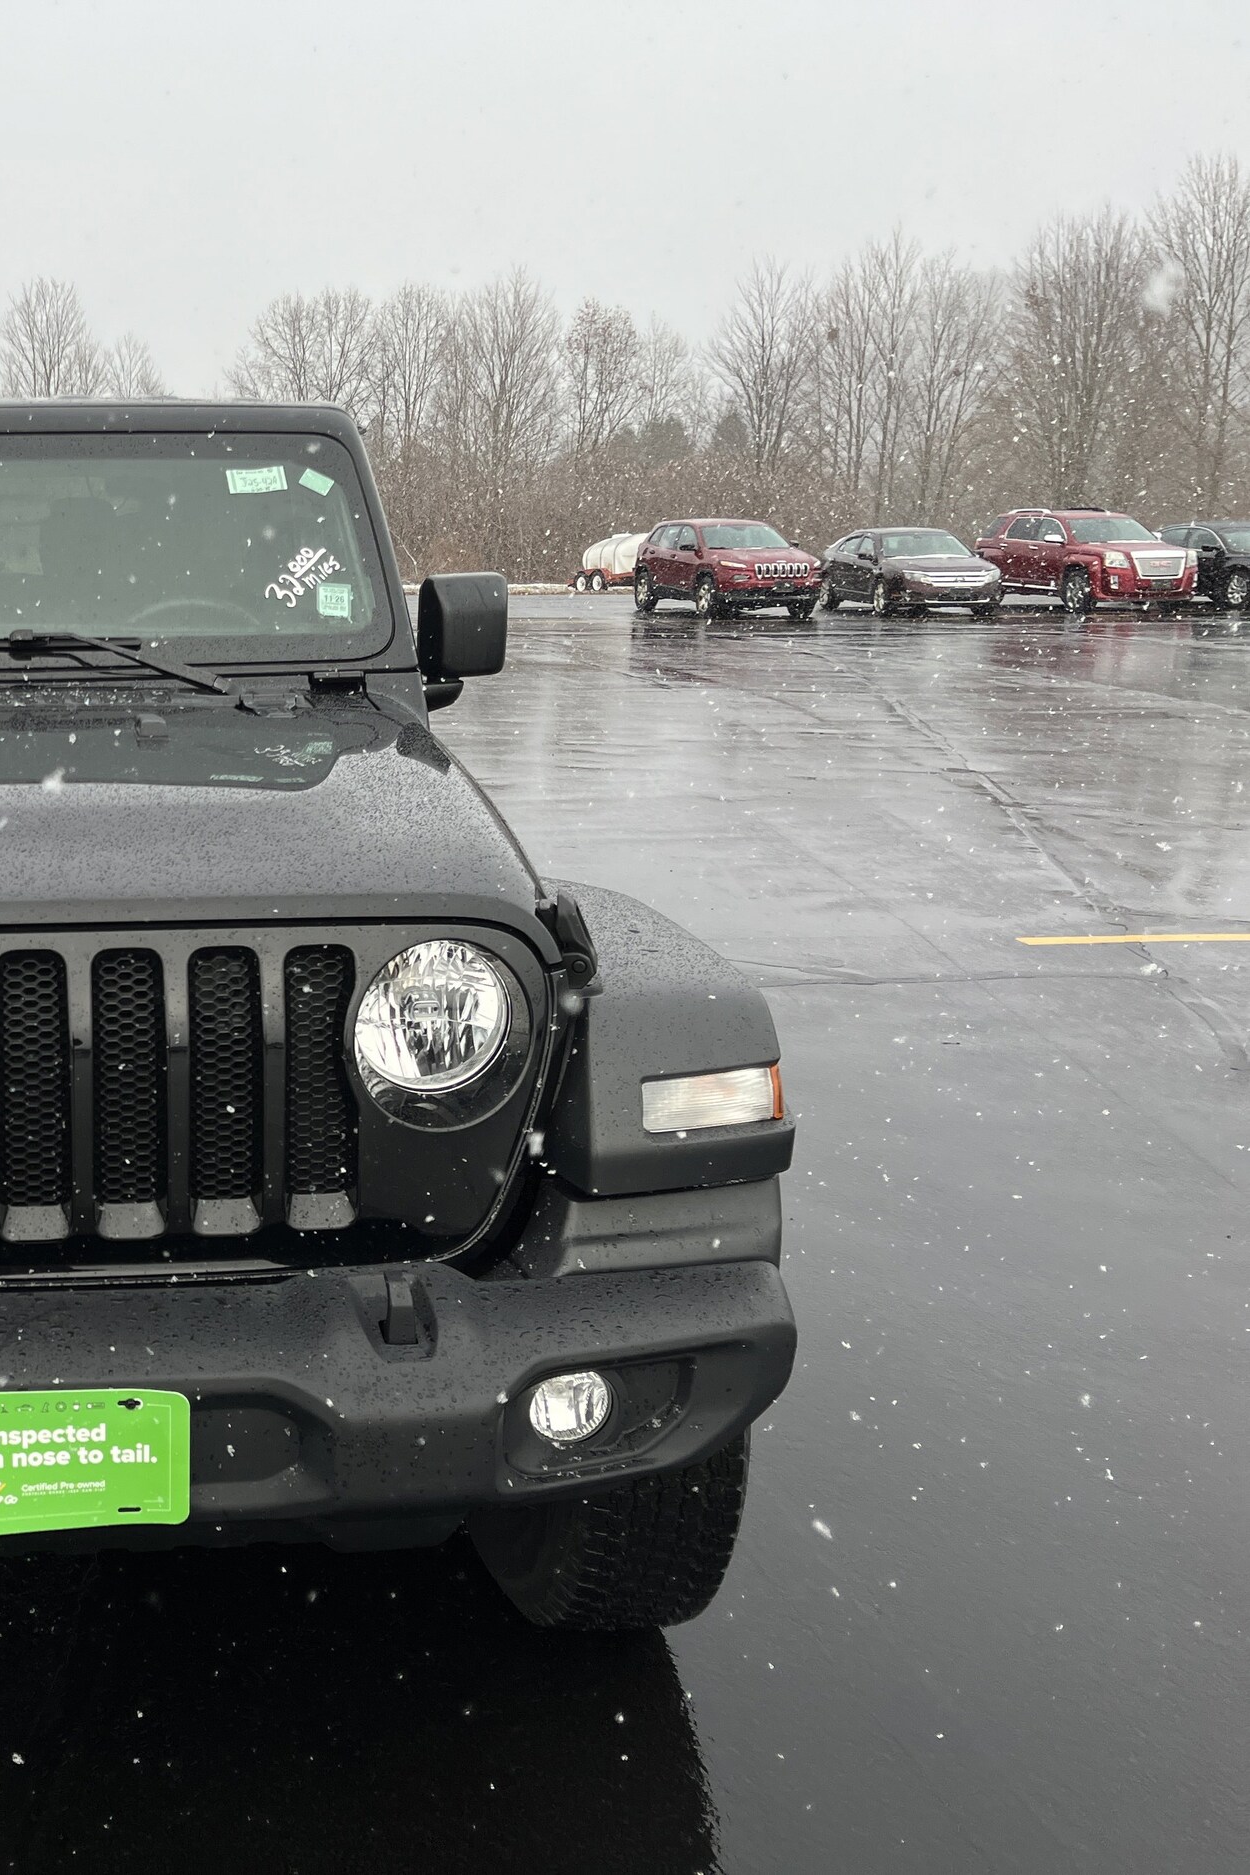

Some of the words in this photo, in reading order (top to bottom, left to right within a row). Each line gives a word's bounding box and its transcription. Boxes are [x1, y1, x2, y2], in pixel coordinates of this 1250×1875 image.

[11, 1449, 71, 1468] nose
[77, 1445, 104, 1465] to
[110, 1444, 158, 1464] tail.
[21, 1482, 58, 1492] Certified
